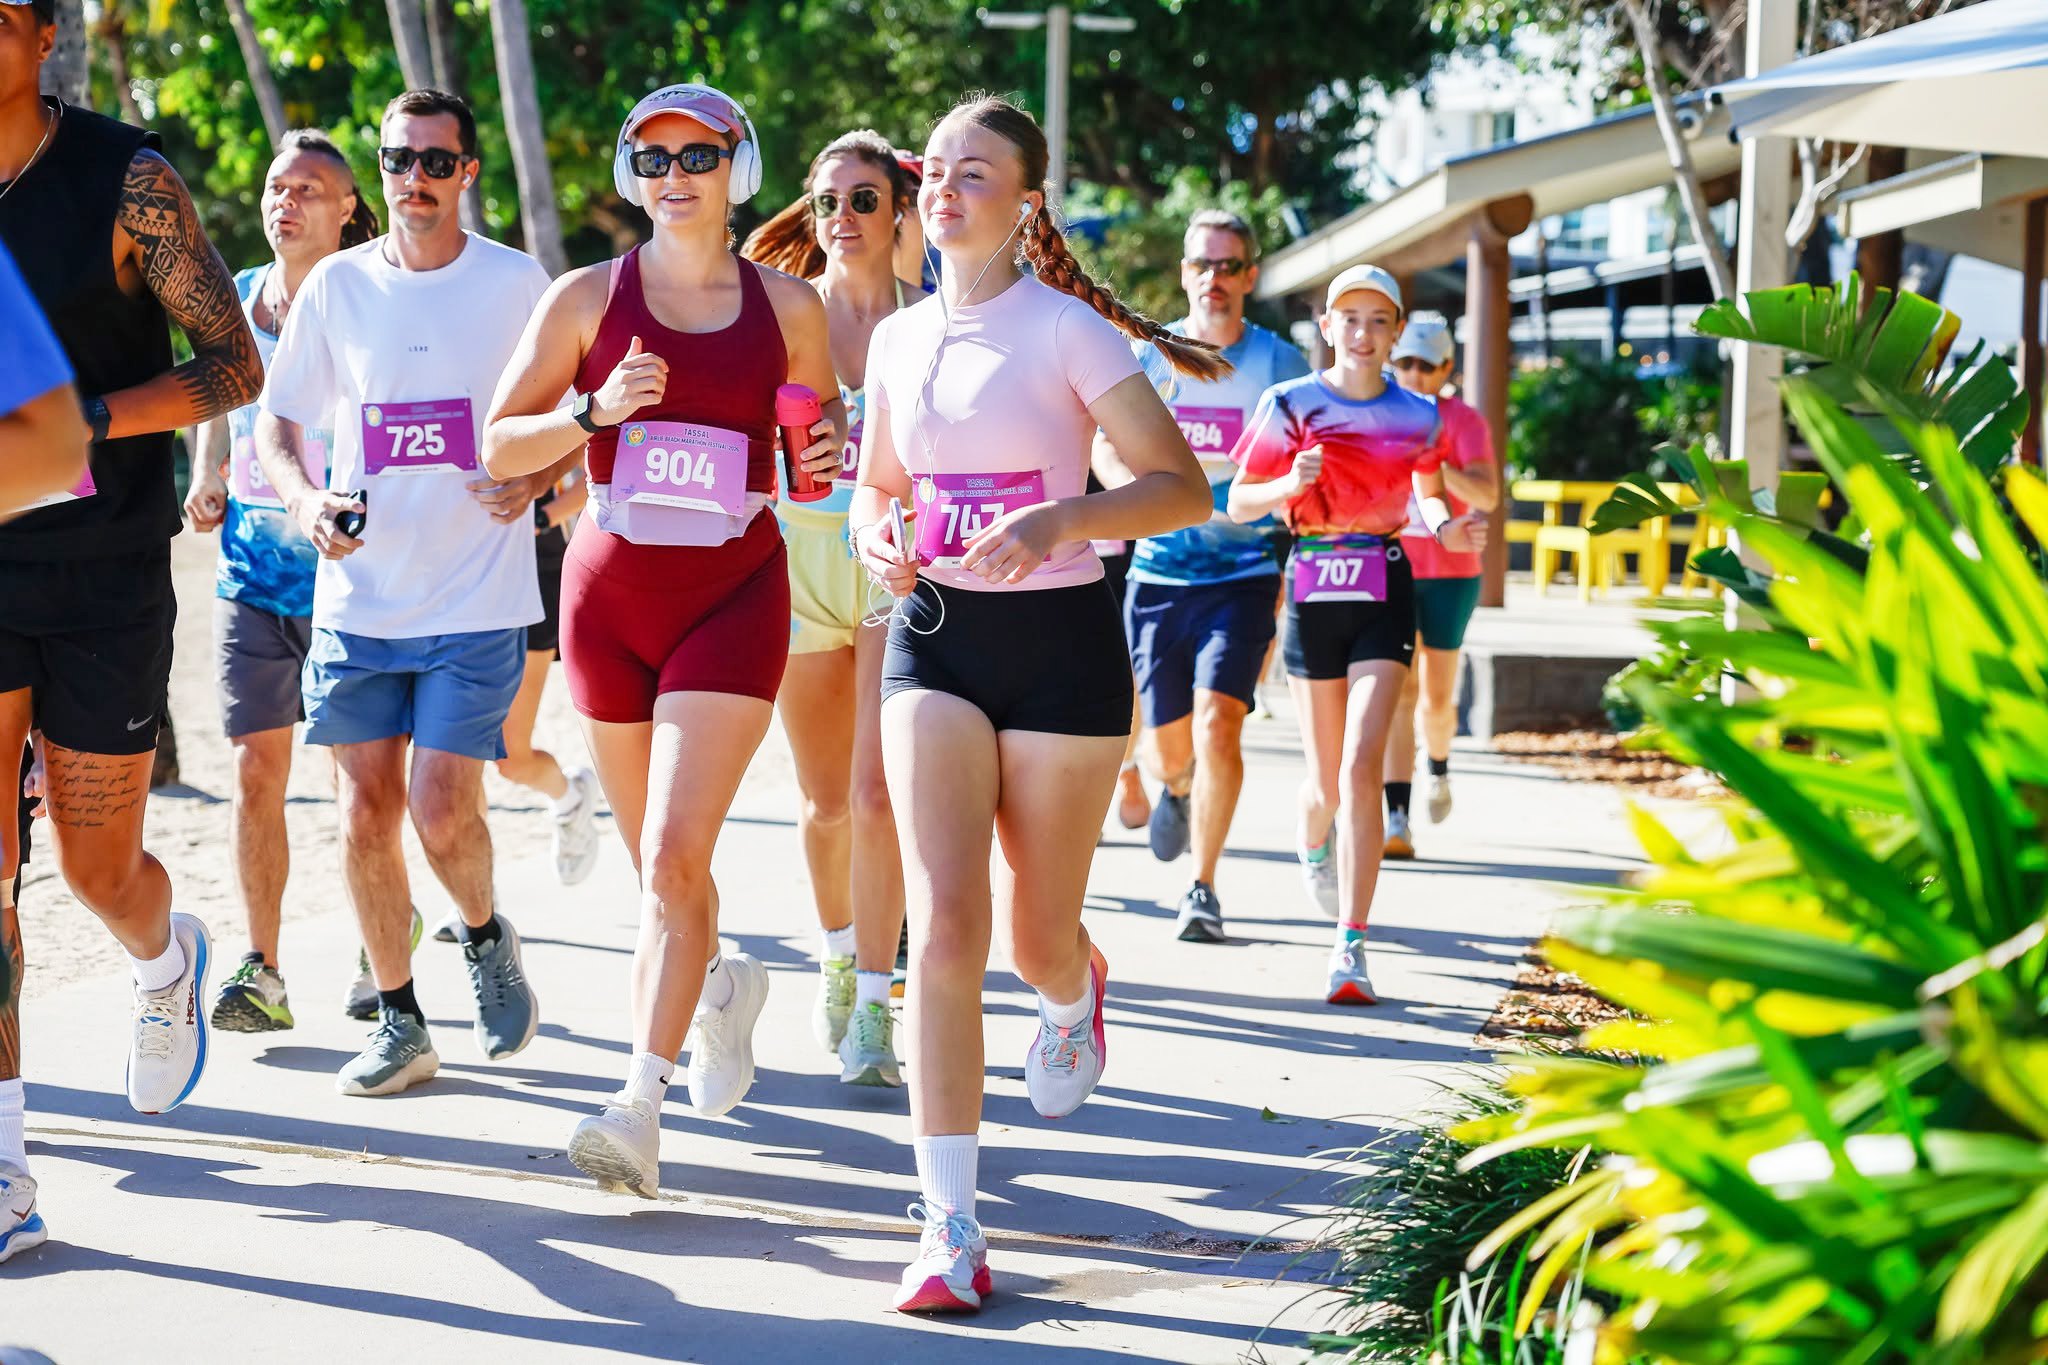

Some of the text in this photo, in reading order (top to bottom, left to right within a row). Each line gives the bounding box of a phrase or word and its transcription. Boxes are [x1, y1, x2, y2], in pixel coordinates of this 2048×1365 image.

[386, 423, 446, 458] 725
[681, 438, 707, 447] MARATHON
[708, 441, 727, 449] FESTIVAL
[684, 428, 710, 439] TASSAL
[1177, 421, 1222, 448] 784
[645, 447, 715, 490] 904
[965, 489, 993, 497] MARATHON
[993, 487, 1017, 496] FESTIVAL
[966, 478, 994, 488] TASSAL
[940, 502, 1005, 545] 747
[1315, 558, 1364, 586] 707
